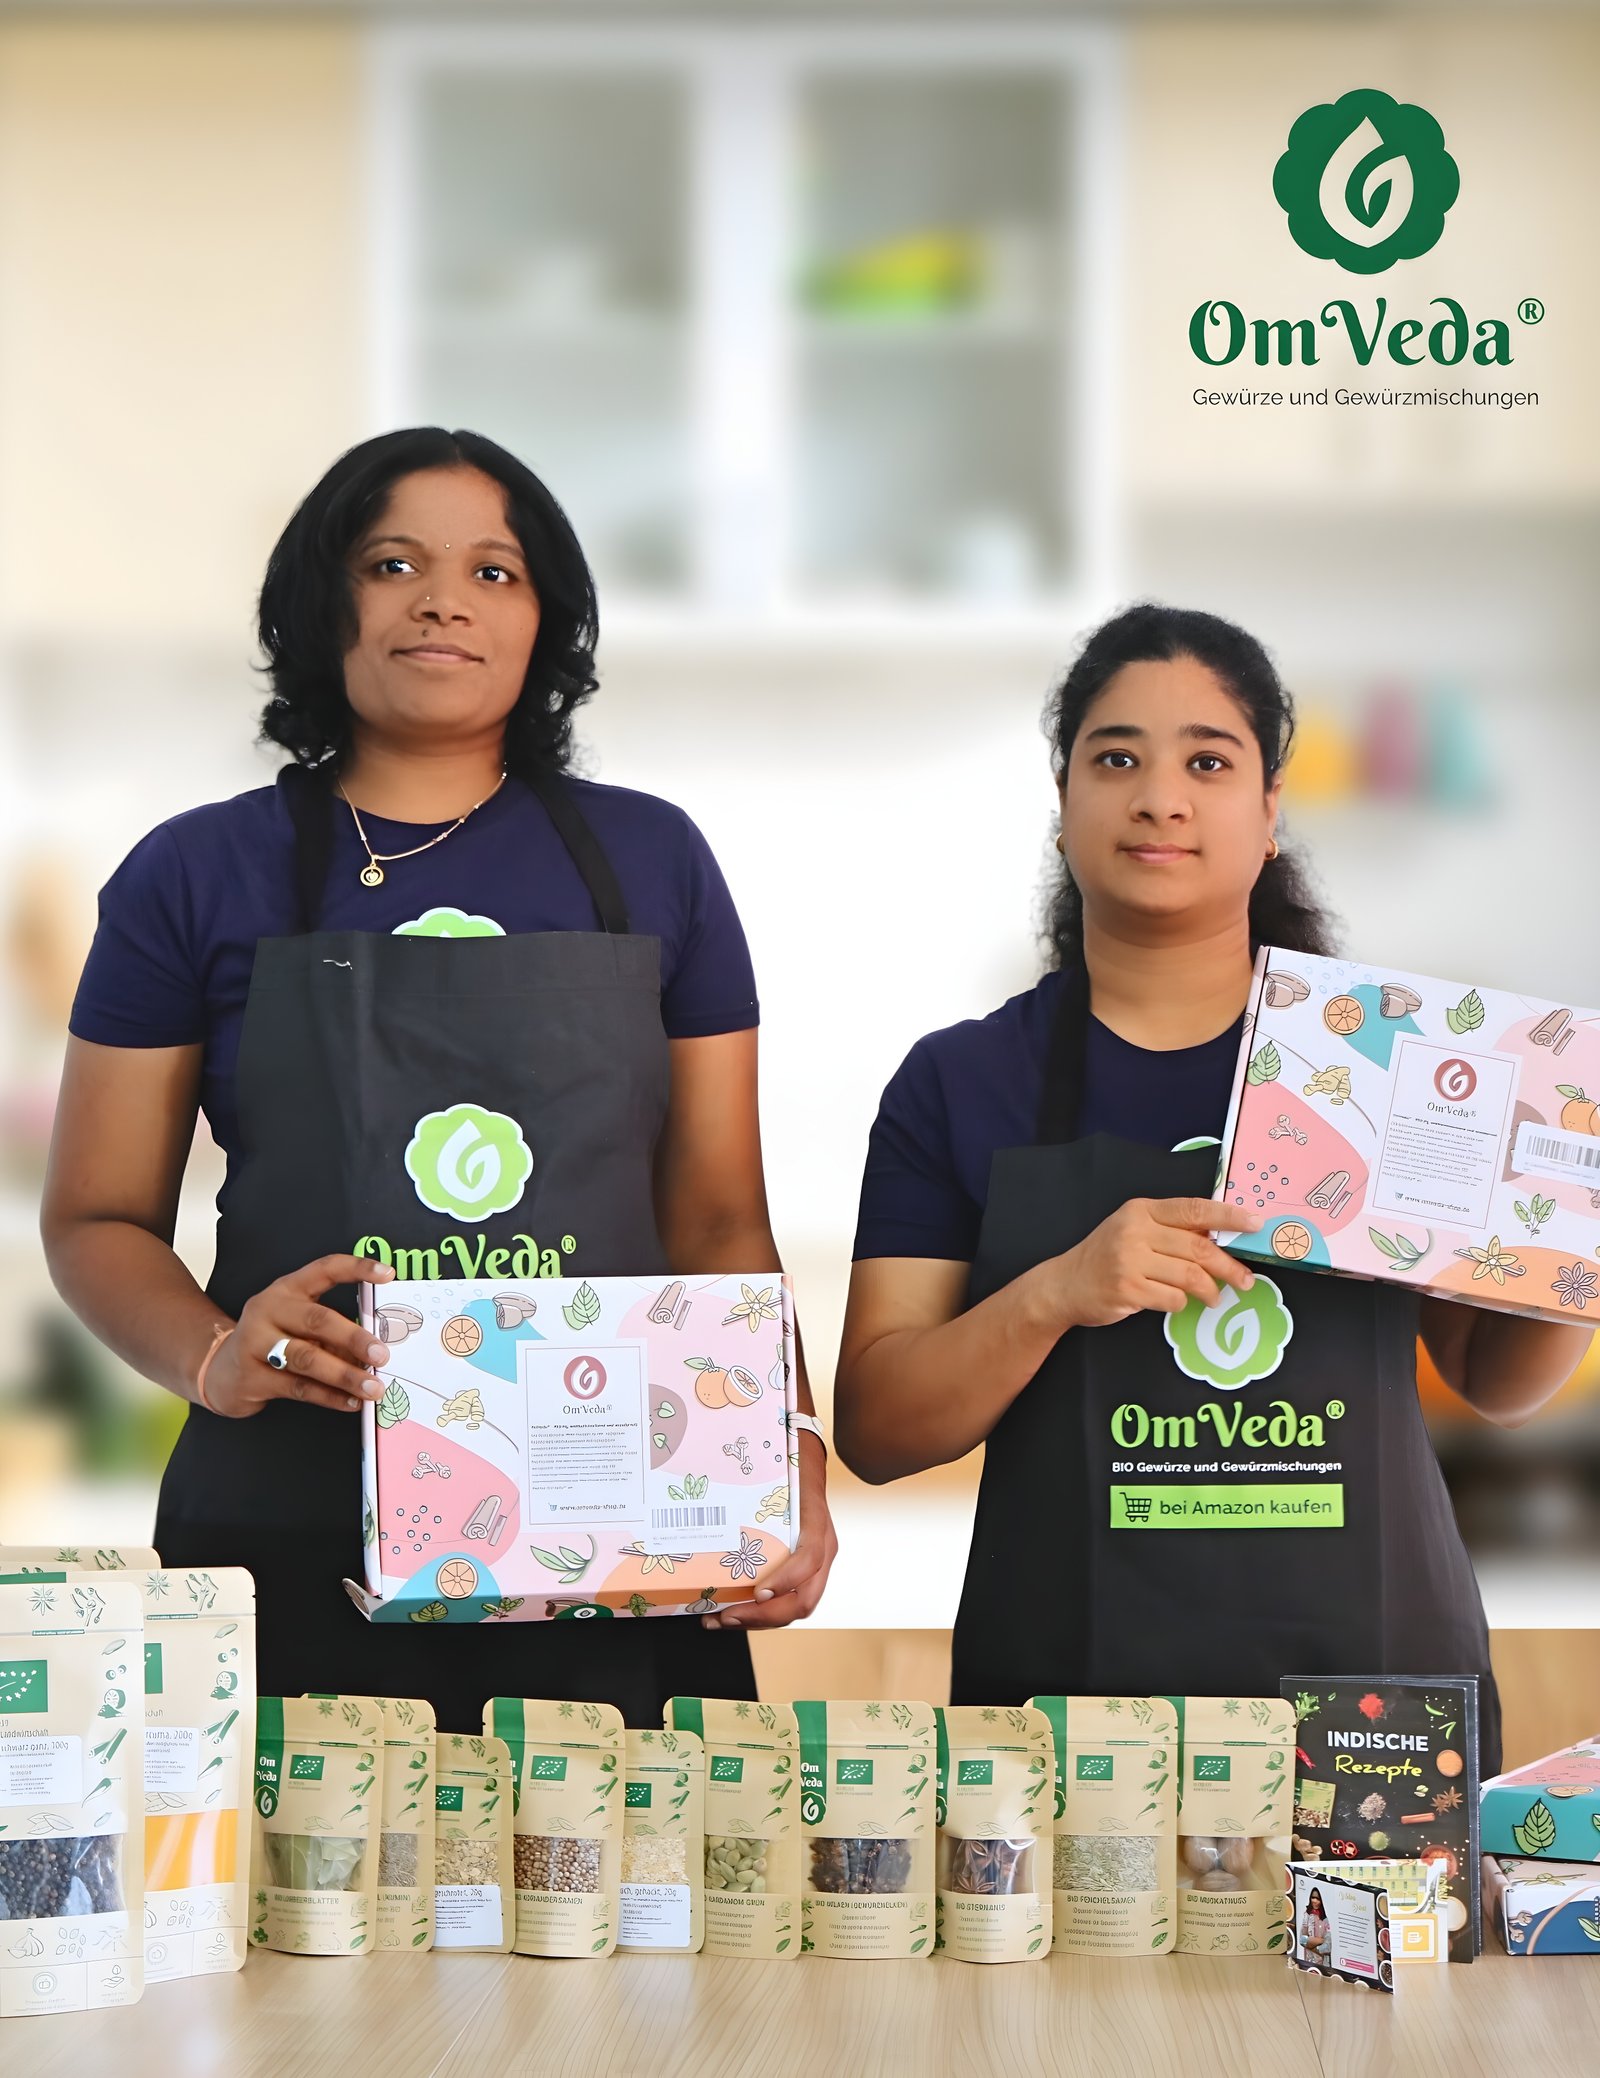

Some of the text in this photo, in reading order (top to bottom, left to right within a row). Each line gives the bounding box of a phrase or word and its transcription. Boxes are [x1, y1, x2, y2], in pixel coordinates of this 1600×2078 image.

[1112, 1460, 1343, 1474] BIO Gewürze und Gewürzmischungen
[1159, 1499, 1332, 1515] bei Amazon kaufen
[1327, 1730, 1429, 1752] INDISCHE
[259, 1756, 276, 1767] Om
[800, 1762, 820, 1773] Om
[1334, 1754, 1424, 1783] Rezepte
[256, 1770, 277, 1782] Veda
[800, 1777, 823, 1788] Veda
